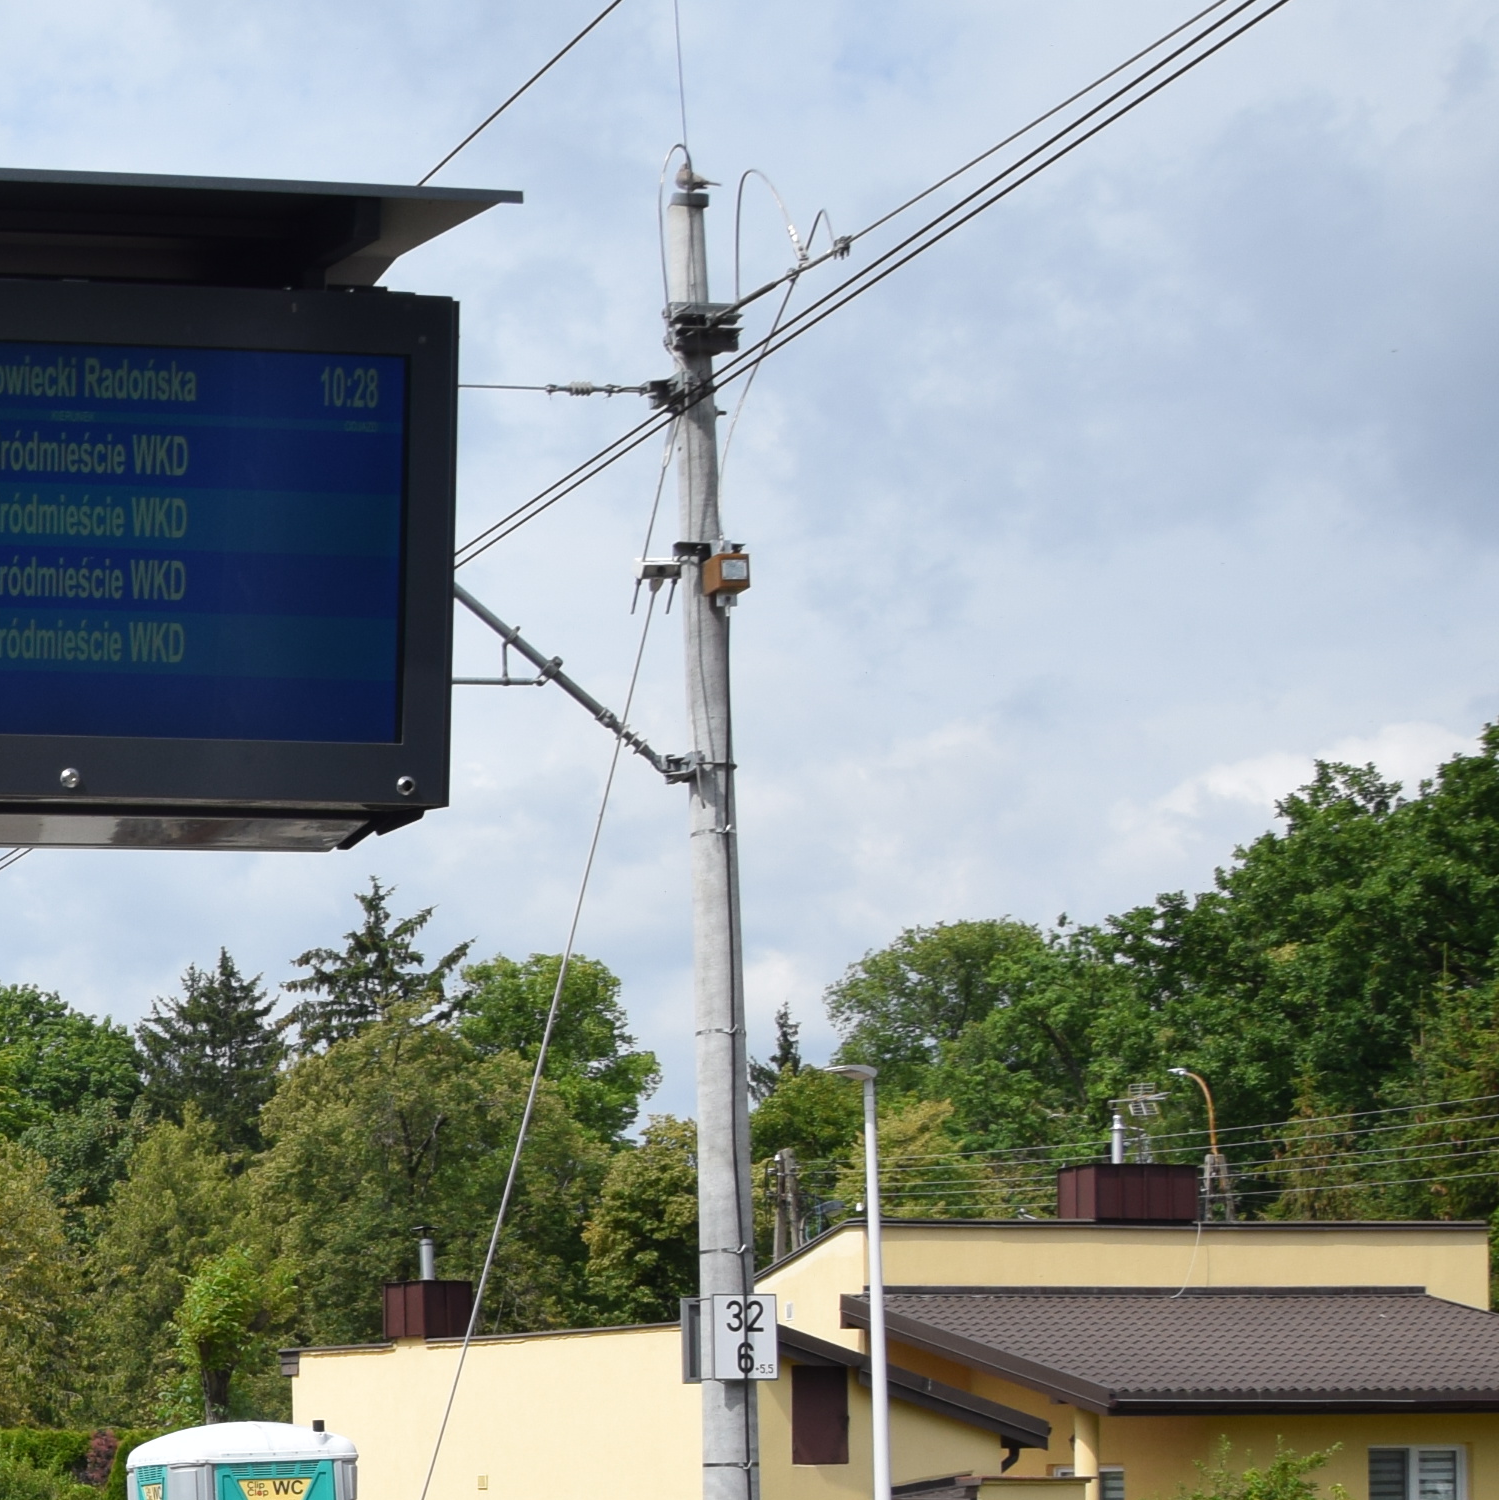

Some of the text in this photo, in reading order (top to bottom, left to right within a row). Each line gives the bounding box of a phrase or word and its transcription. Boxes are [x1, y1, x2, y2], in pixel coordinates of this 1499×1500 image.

[85, 357, 197, 401] Radońska
[321, 366, 379, 408] 10:28
[133, 434, 189, 476] WKD
[131, 497, 187, 538] WKD
[131, 559, 186, 600] WKD
[129, 622, 185, 663] WKD
[726, 1300, 764, 1332] 32
[737, 1341, 754, 1374] 6
[247, 1480, 303, 1495] Clip WC
